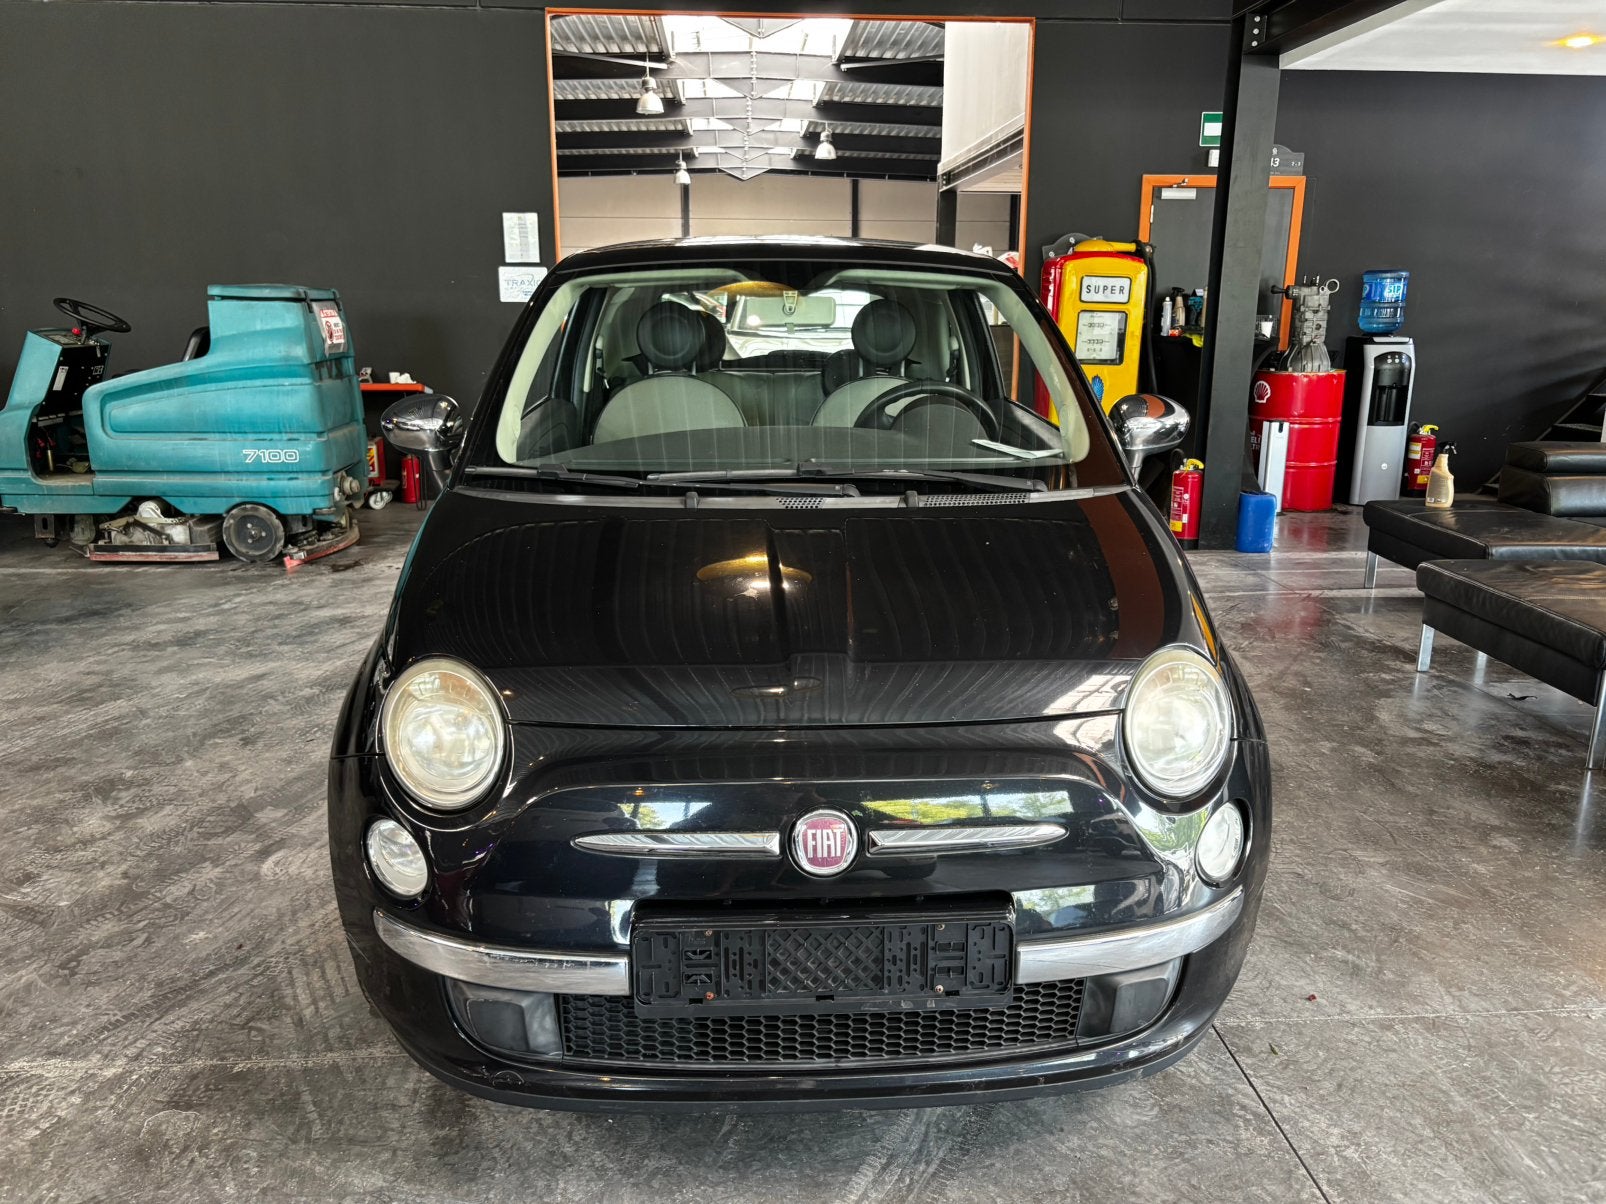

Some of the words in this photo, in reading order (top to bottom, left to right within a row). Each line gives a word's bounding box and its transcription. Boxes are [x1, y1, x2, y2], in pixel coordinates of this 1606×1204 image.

[1085, 284, 1125, 295] SUPER
[242, 449, 300, 463] 7100
[806, 828, 843, 859] FIAT
